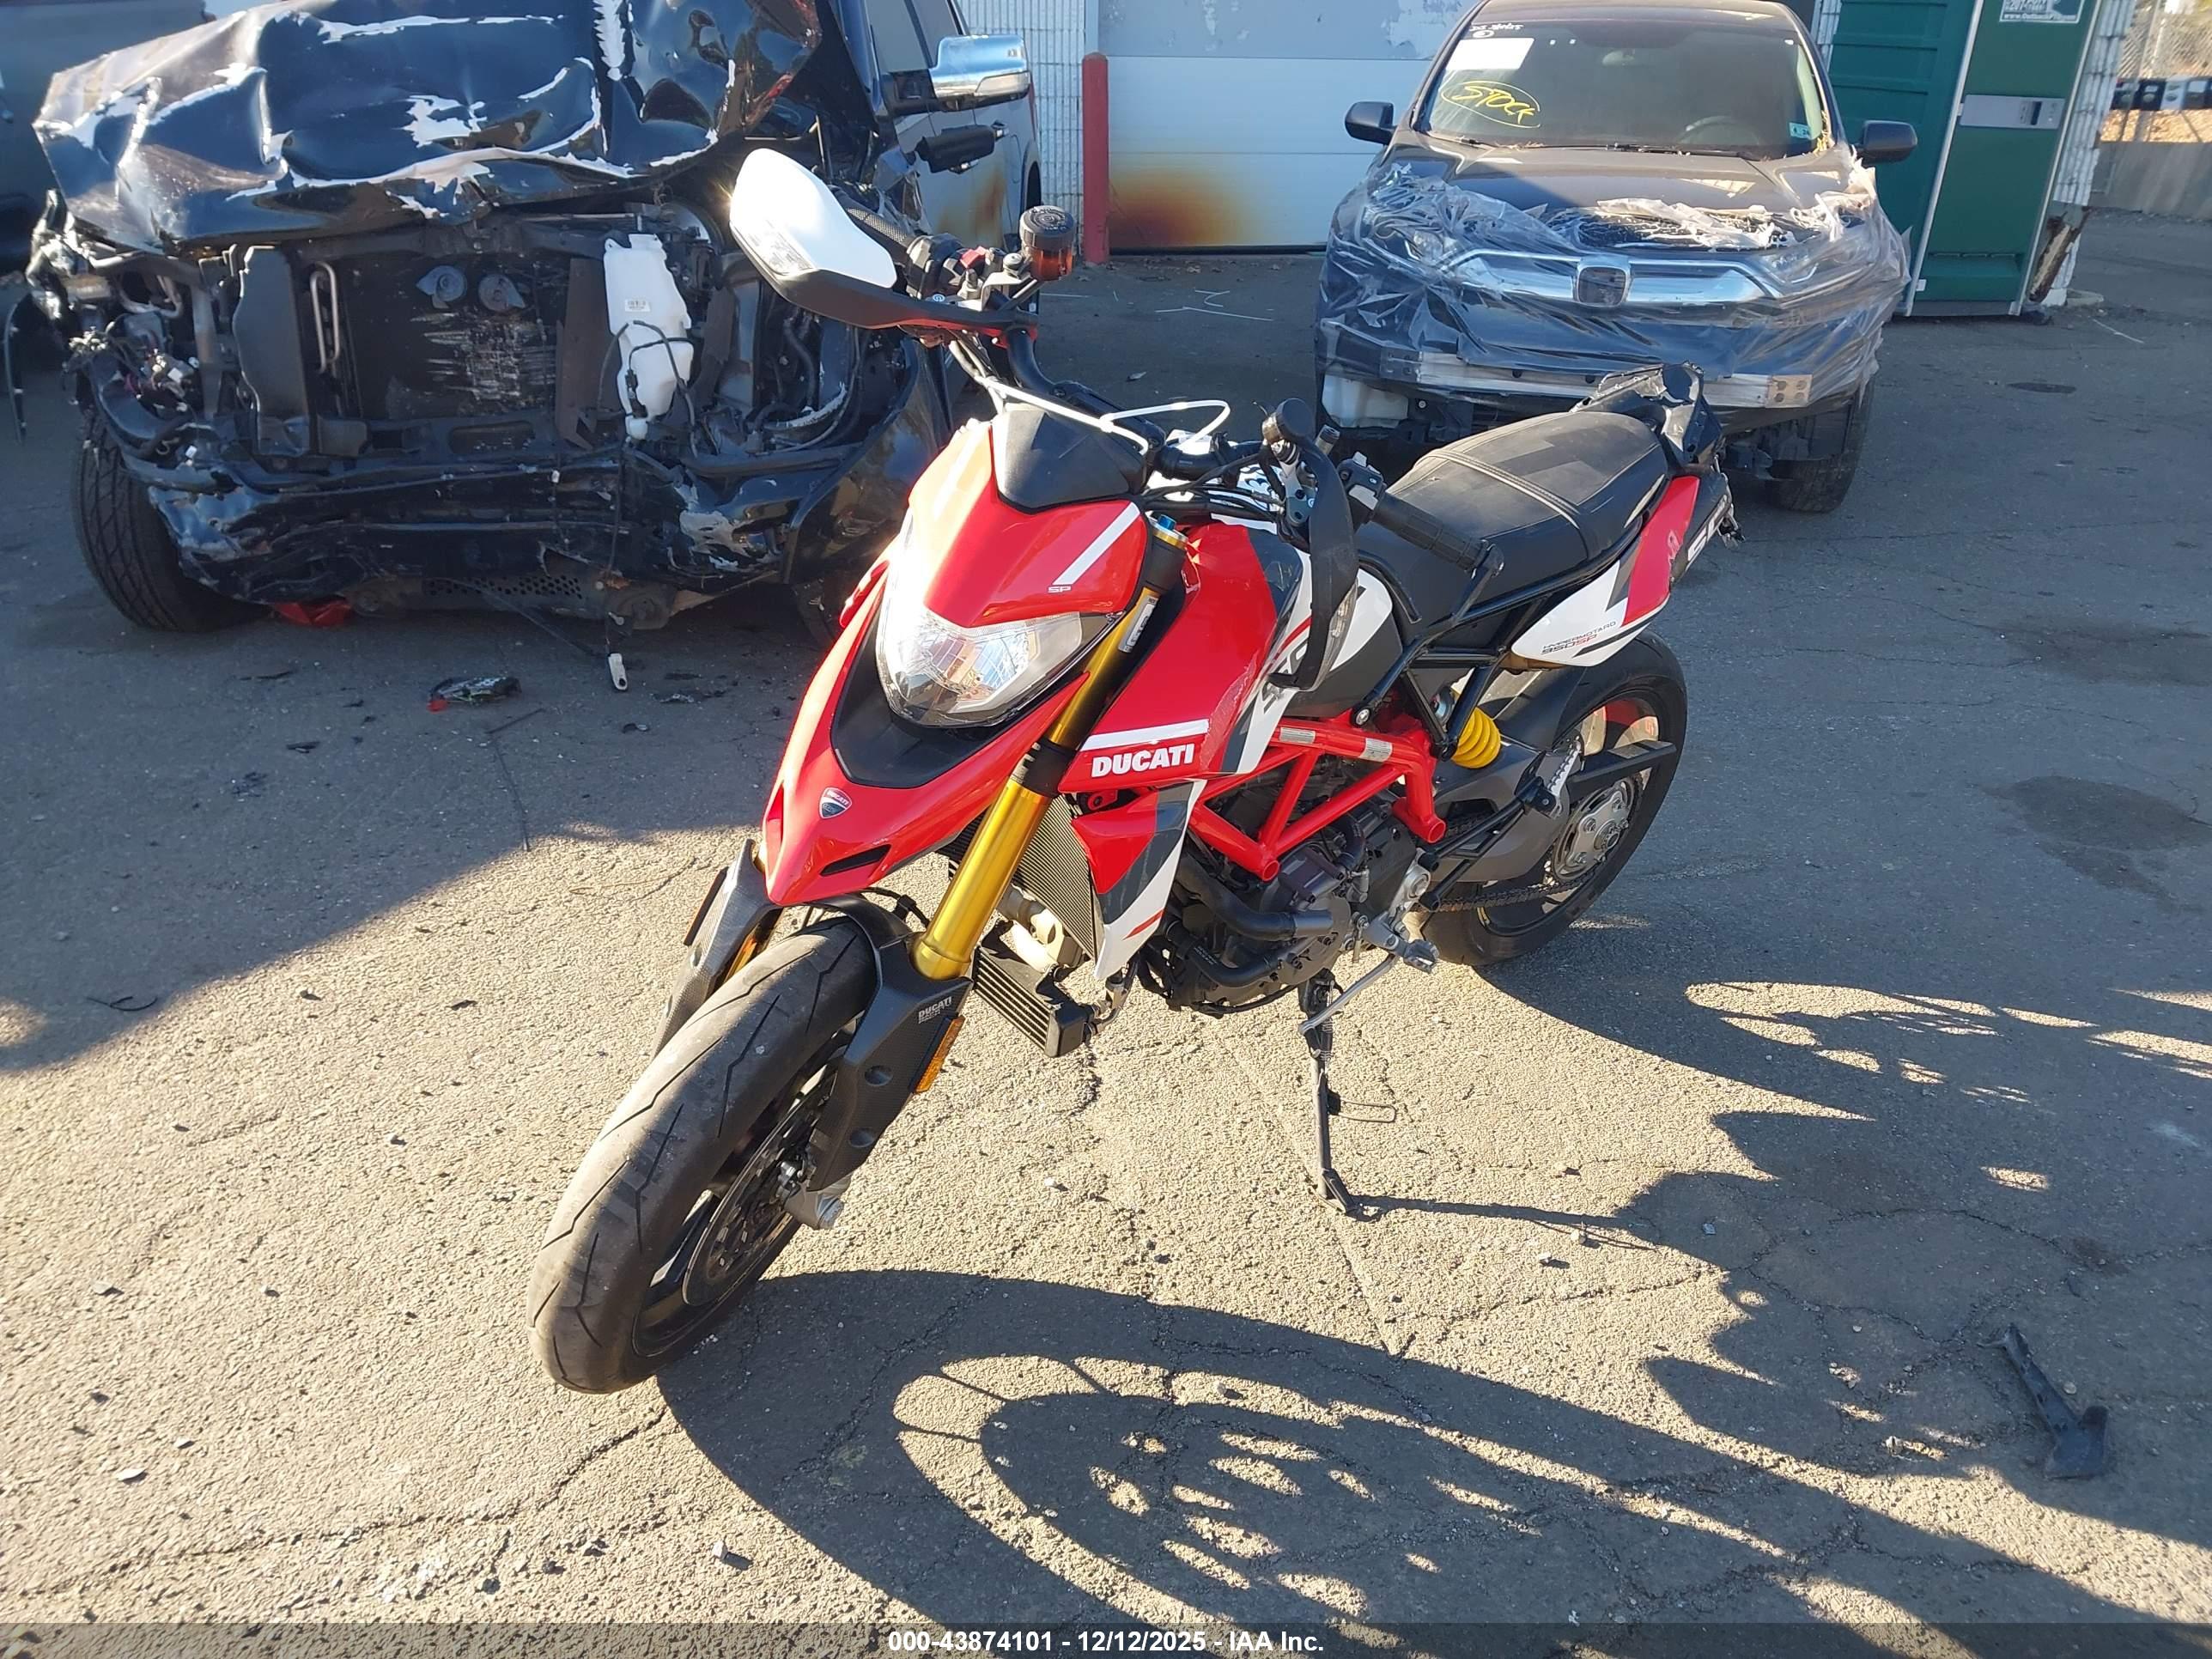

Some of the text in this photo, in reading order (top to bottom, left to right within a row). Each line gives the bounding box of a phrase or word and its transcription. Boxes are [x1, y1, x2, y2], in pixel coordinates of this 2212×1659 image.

[1452, 85, 1535, 125] STOCK
[1048, 585, 1072, 593] SP
[1091, 744, 1195, 778] DUCATI
[918, 996, 952, 1018] DUCATI
